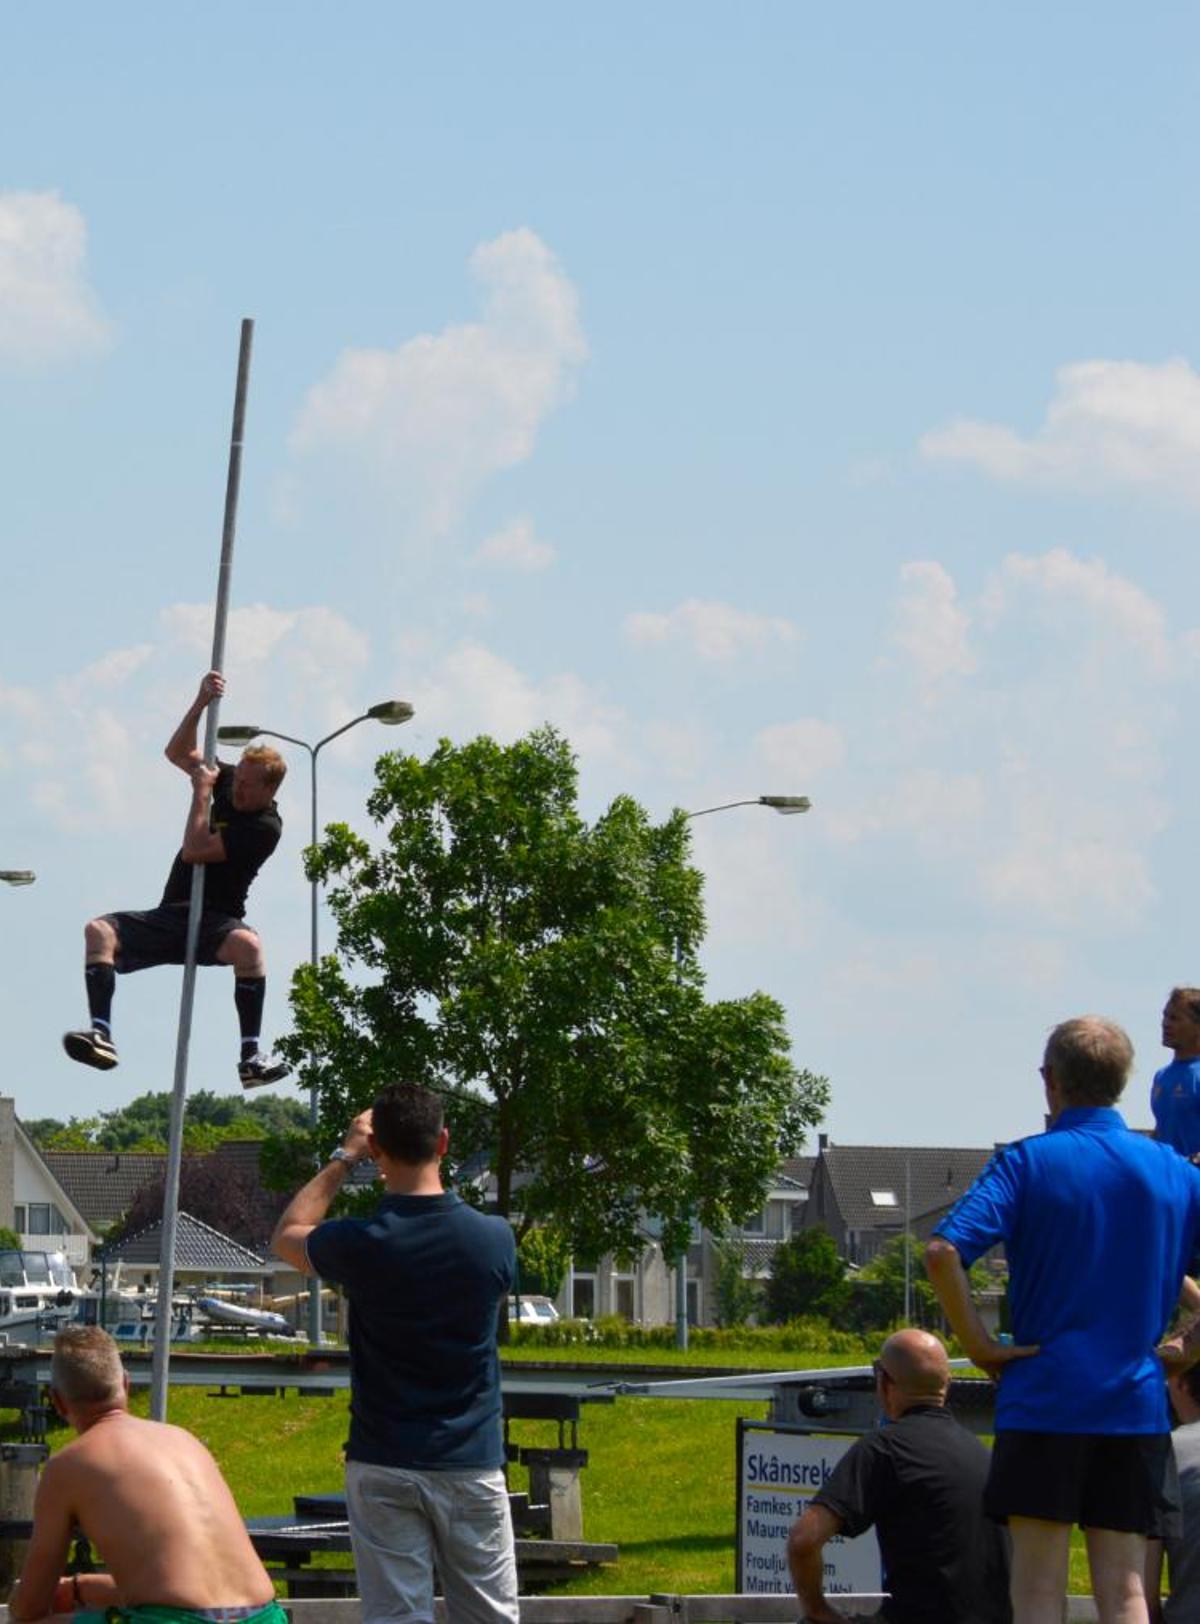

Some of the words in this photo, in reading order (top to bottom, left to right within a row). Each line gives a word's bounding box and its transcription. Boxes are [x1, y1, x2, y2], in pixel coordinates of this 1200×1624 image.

[747, 1454, 834, 1486] Skânsrek
[747, 1496, 793, 1516] Famkes
[747, 1520, 788, 1539] Maure
[746, 1576, 782, 1594] Marrit
